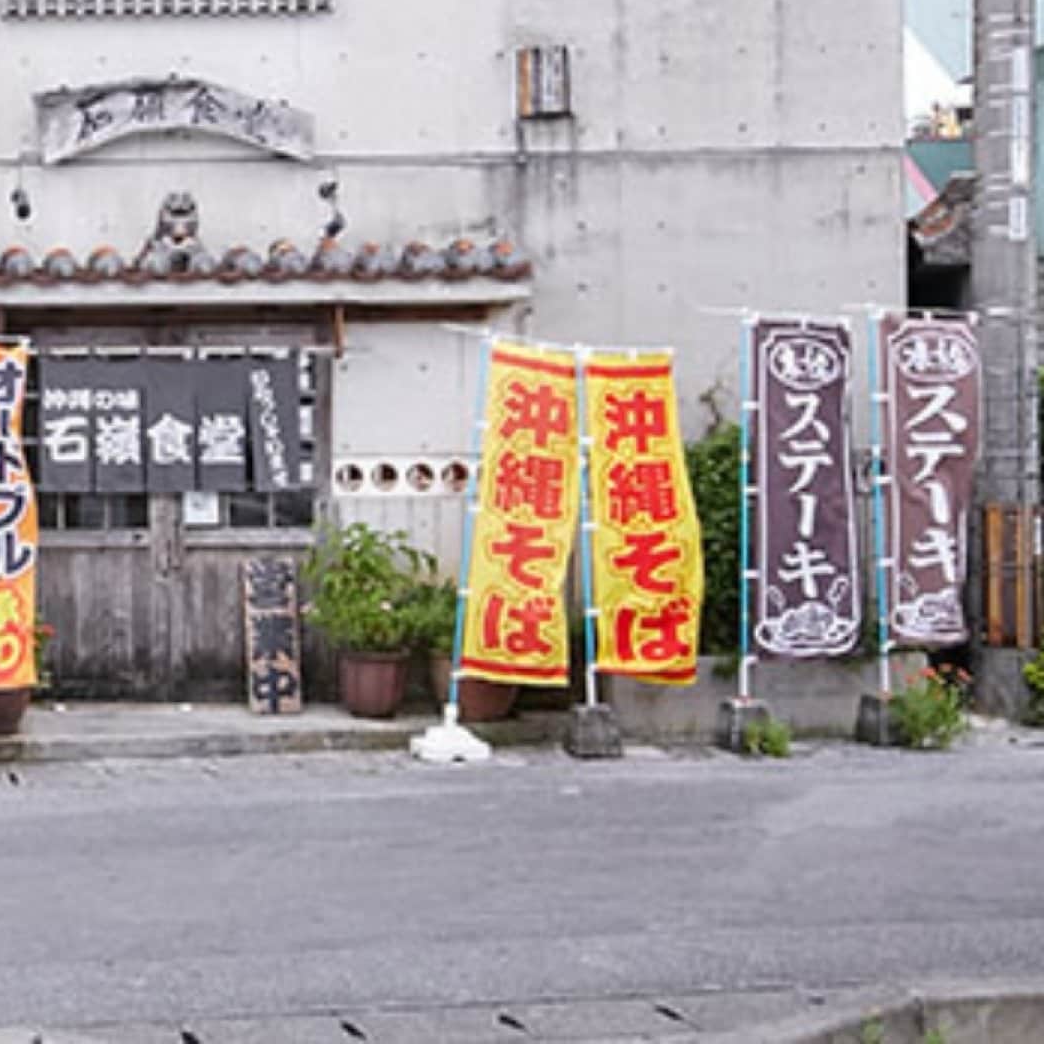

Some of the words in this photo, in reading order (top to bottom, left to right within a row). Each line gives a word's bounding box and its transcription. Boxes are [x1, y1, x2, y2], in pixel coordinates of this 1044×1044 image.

[44, 412, 246, 466] 石嶺食堂
[482, 382, 570, 654] 沖縄そば
[604, 390, 692, 662] 沖縄そば
[776, 391, 837, 599] ステーキ
[905, 384, 969, 584] ステーキ
